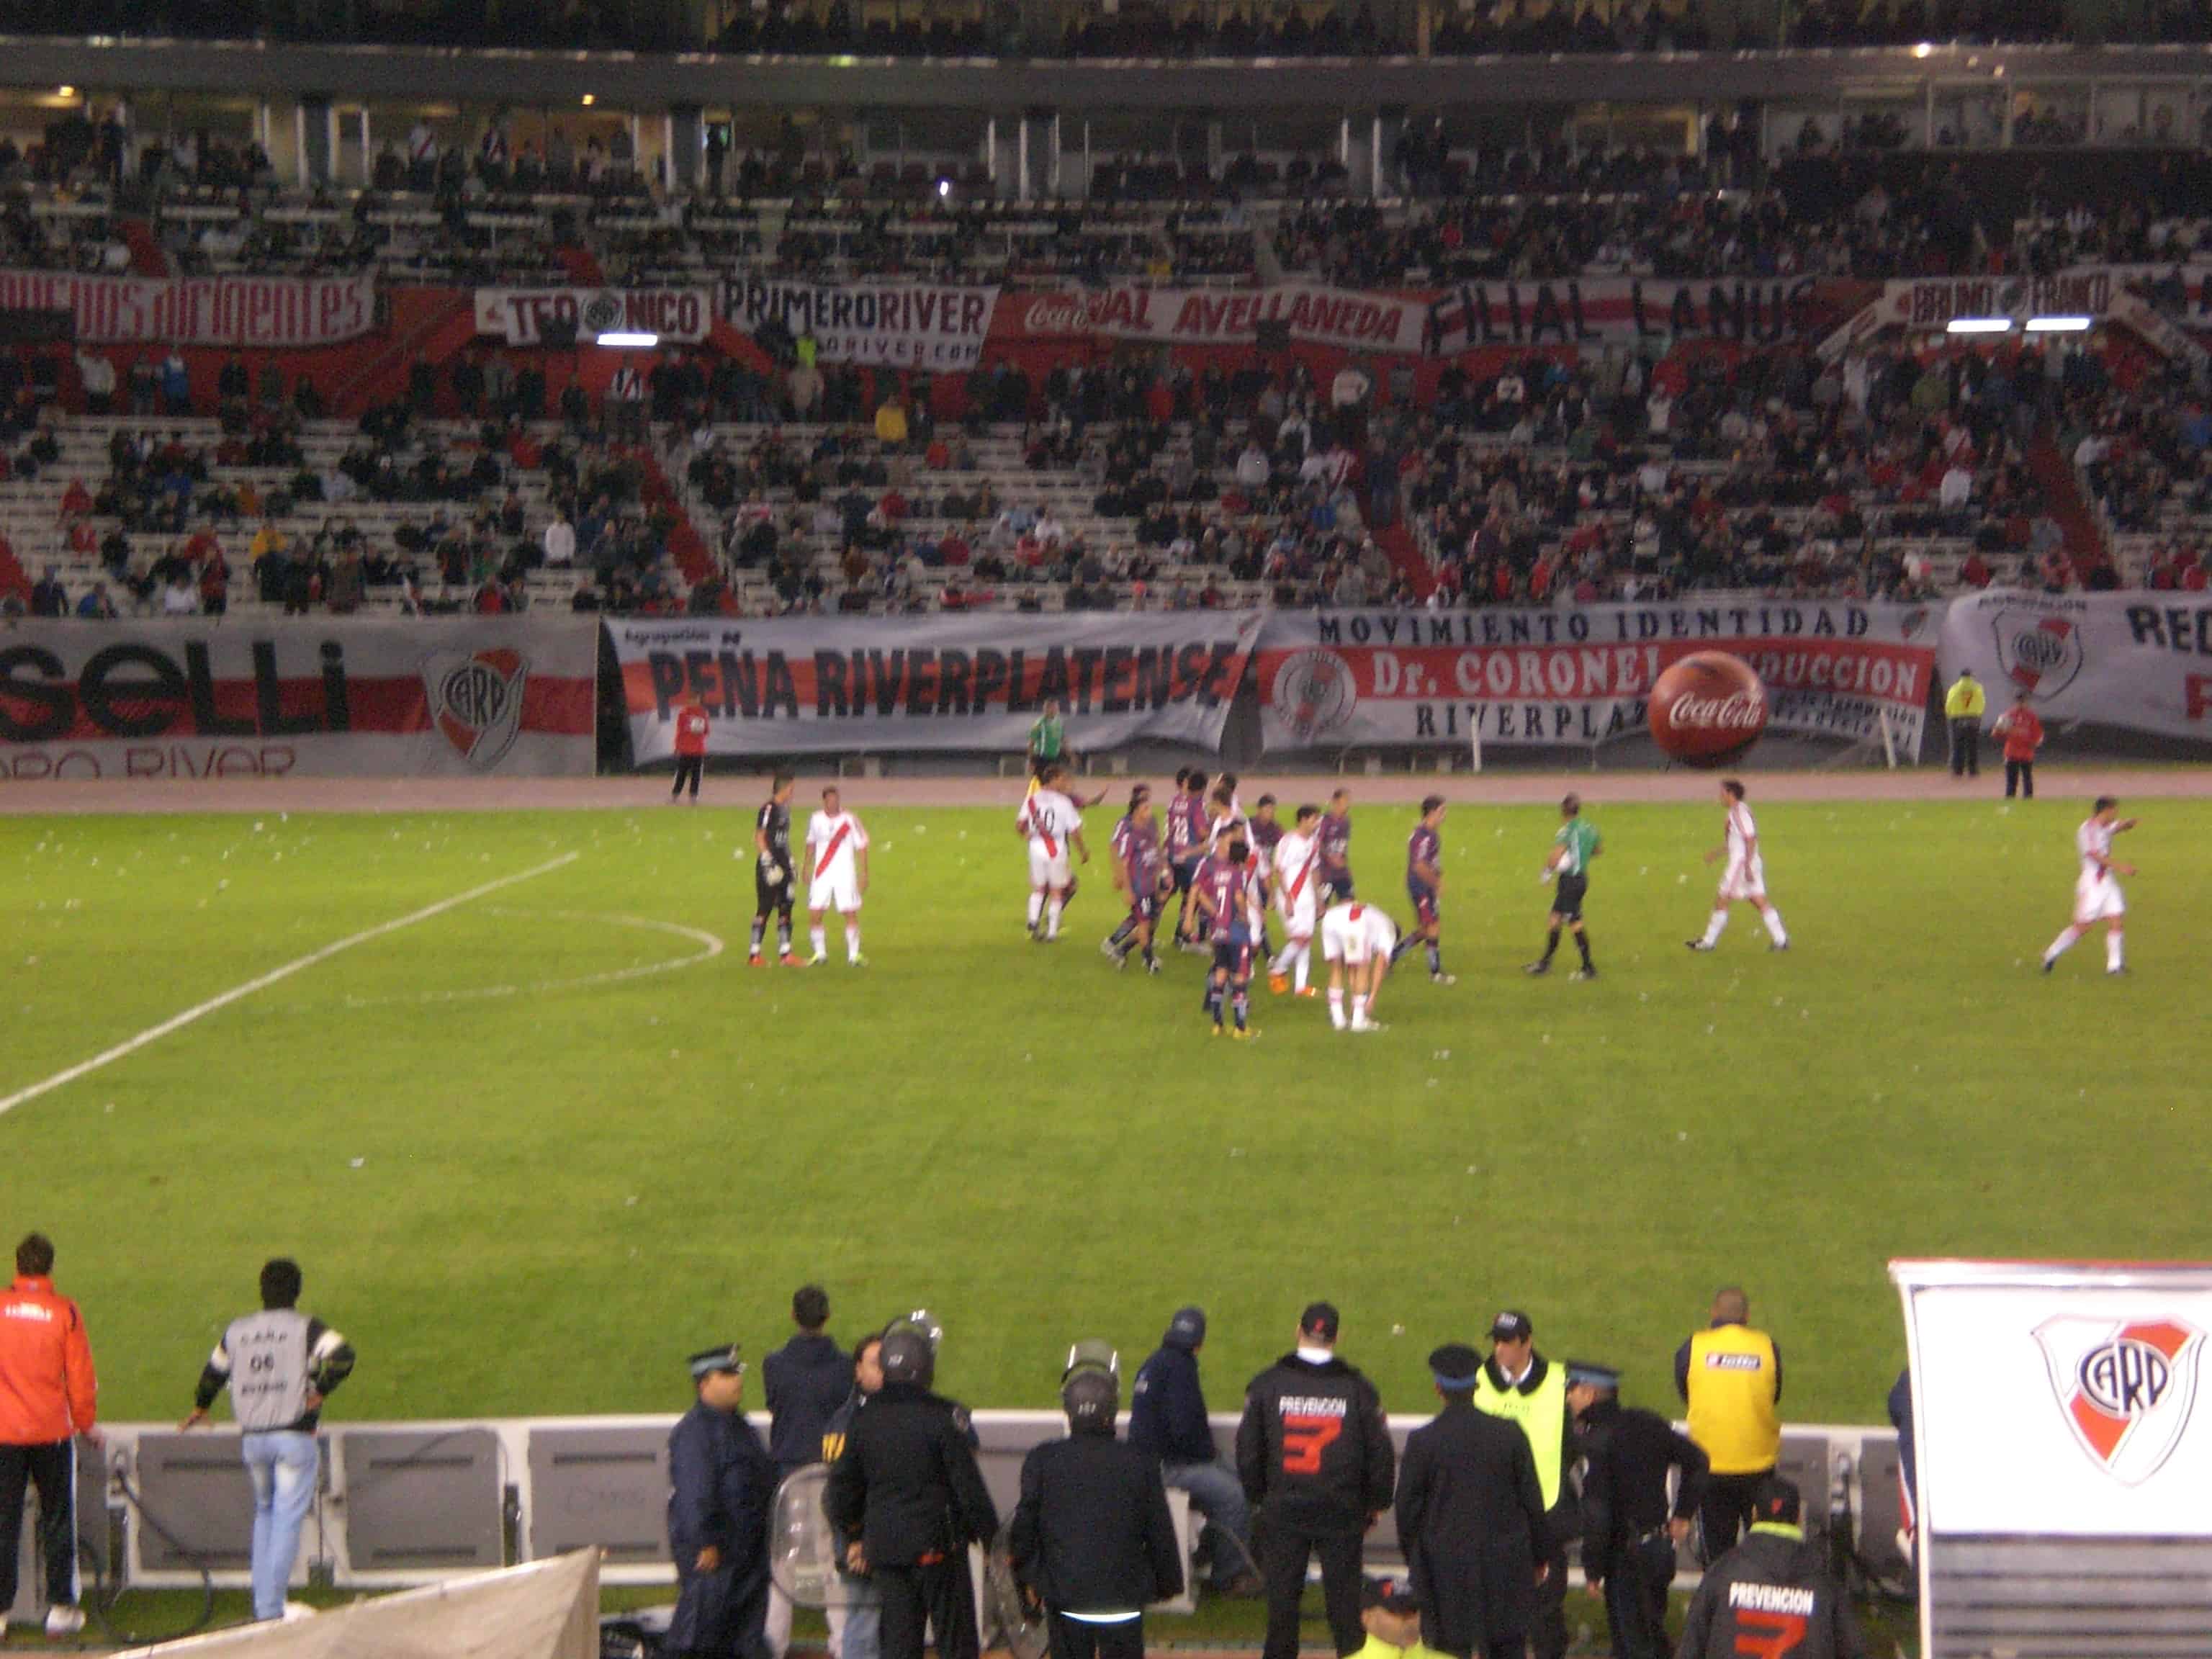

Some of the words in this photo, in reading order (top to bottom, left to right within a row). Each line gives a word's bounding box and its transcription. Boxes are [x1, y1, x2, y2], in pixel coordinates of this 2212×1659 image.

[625, 291, 698, 335] NICO
[1429, 279, 1602, 354] FILIAL
[1318, 613, 1590, 644] MOVIMIENTO
[1617, 608, 1869, 641] IDENTIDAD
[814, 642, 1238, 719] RIVERPLATENSE
[1374, 652, 1437, 696] Dr.
[1279, 1395, 1346, 1418] PREVENCION
[1730, 1582, 1814, 1617] PREVENCION
